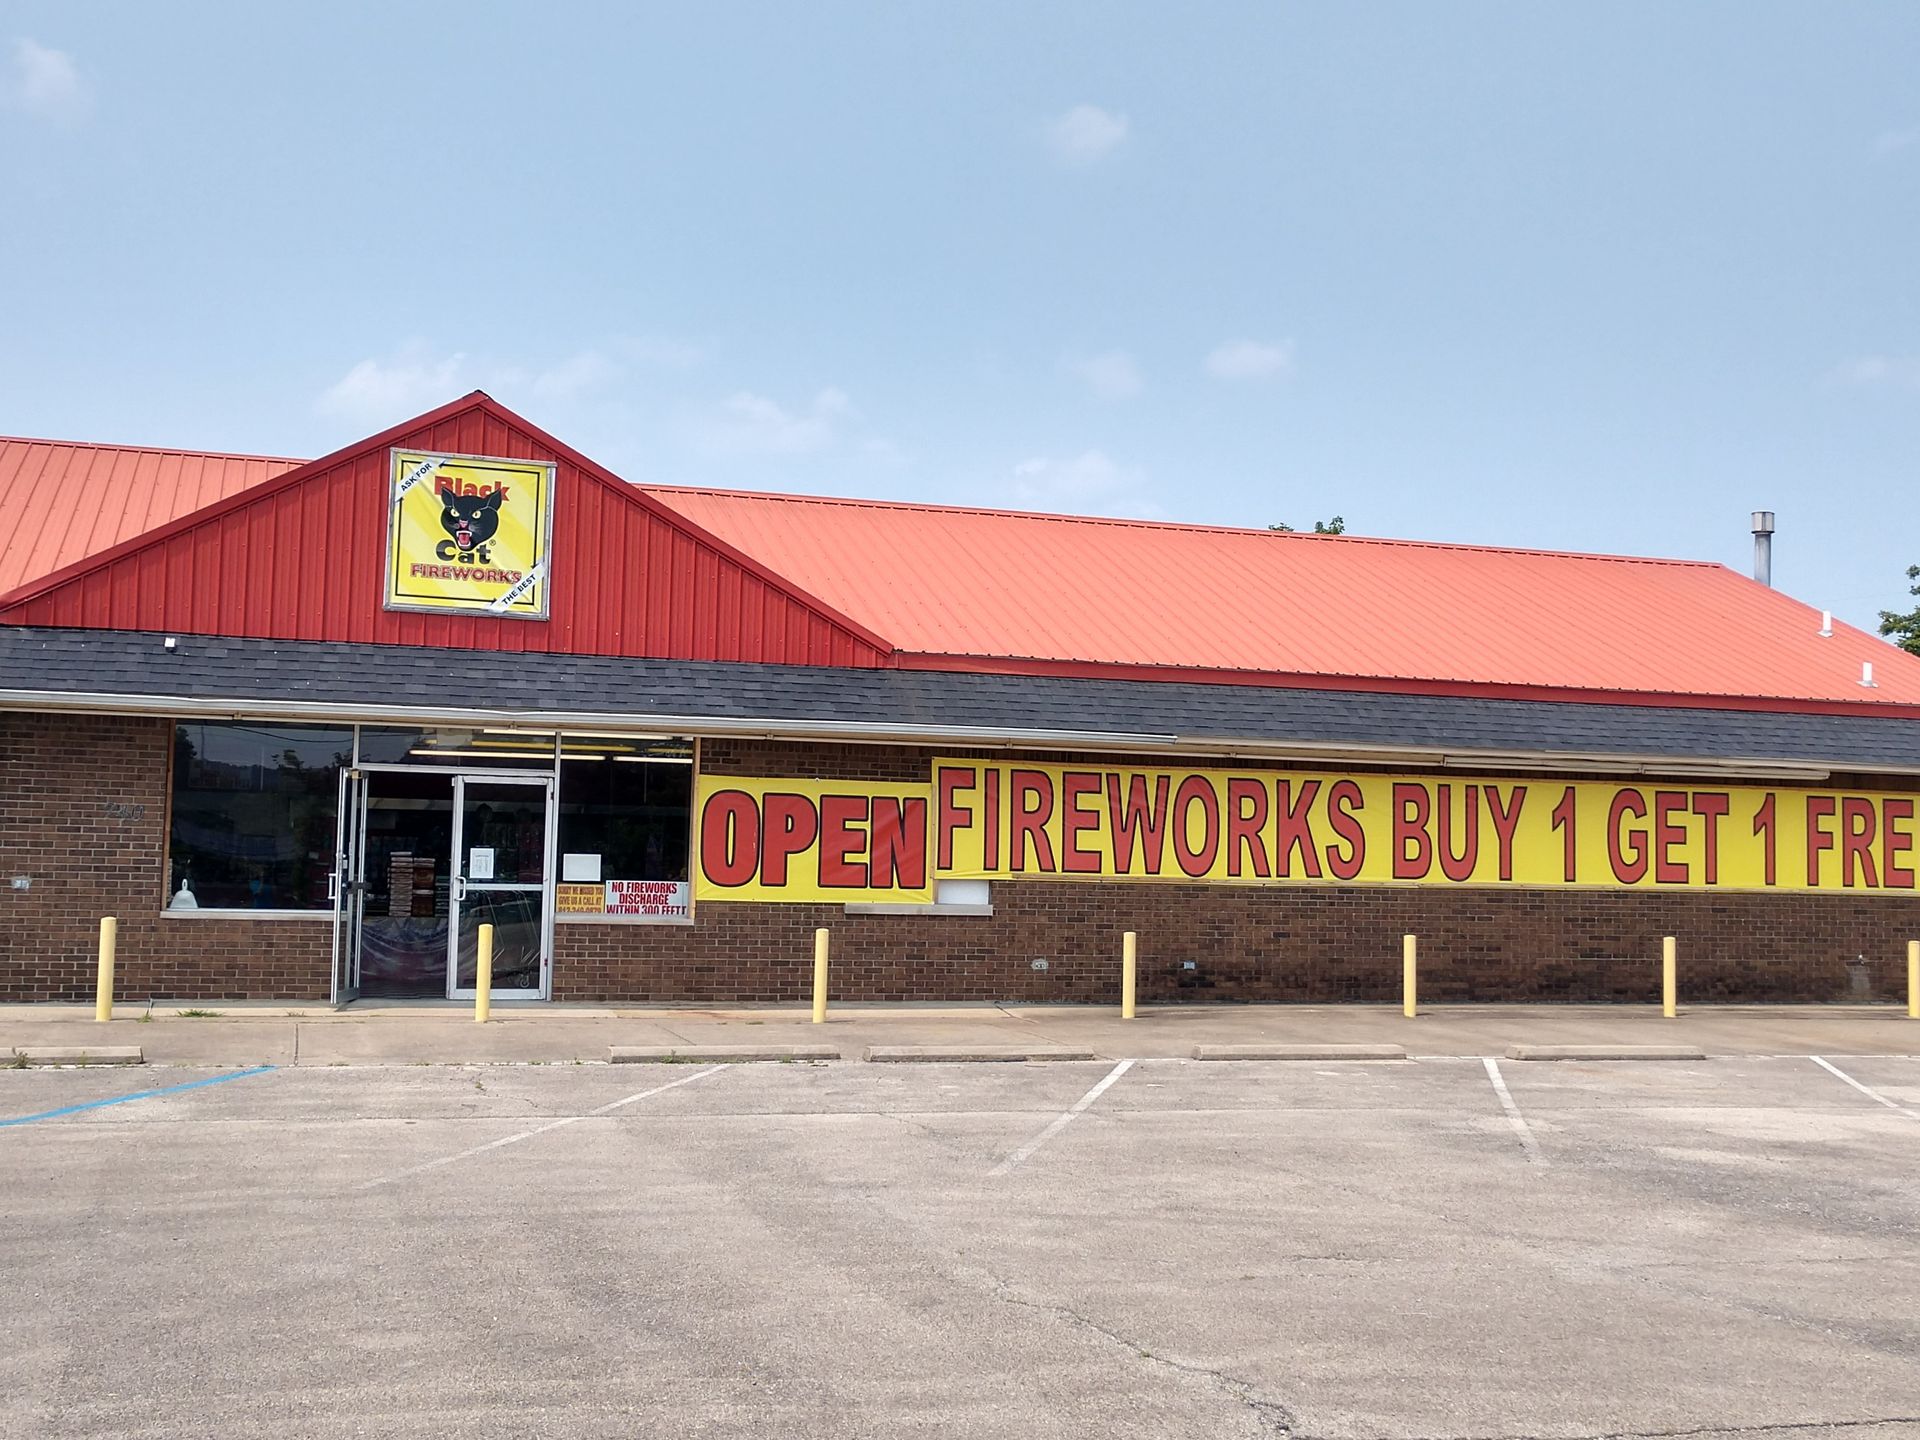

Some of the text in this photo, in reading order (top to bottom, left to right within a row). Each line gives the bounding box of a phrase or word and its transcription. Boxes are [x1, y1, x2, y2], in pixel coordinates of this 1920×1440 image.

[401, 462, 433, 492] ASK FOR
[434, 475, 510, 502] Black
[436, 539, 492, 565] Cat
[410, 563, 522, 585] FIREWORKS
[502, 573, 537, 606] THE BEST
[700, 789, 928, 890] OPEN
[937, 766, 1915, 889] FIREWORKS BUY 1 GET 1 FRE
[611, 881, 677, 894] NO FIREWORKS
[619, 893, 669, 905] DISCHARGE
[606, 904, 640, 914] WITHIN
[641, 904, 660, 914] 300
